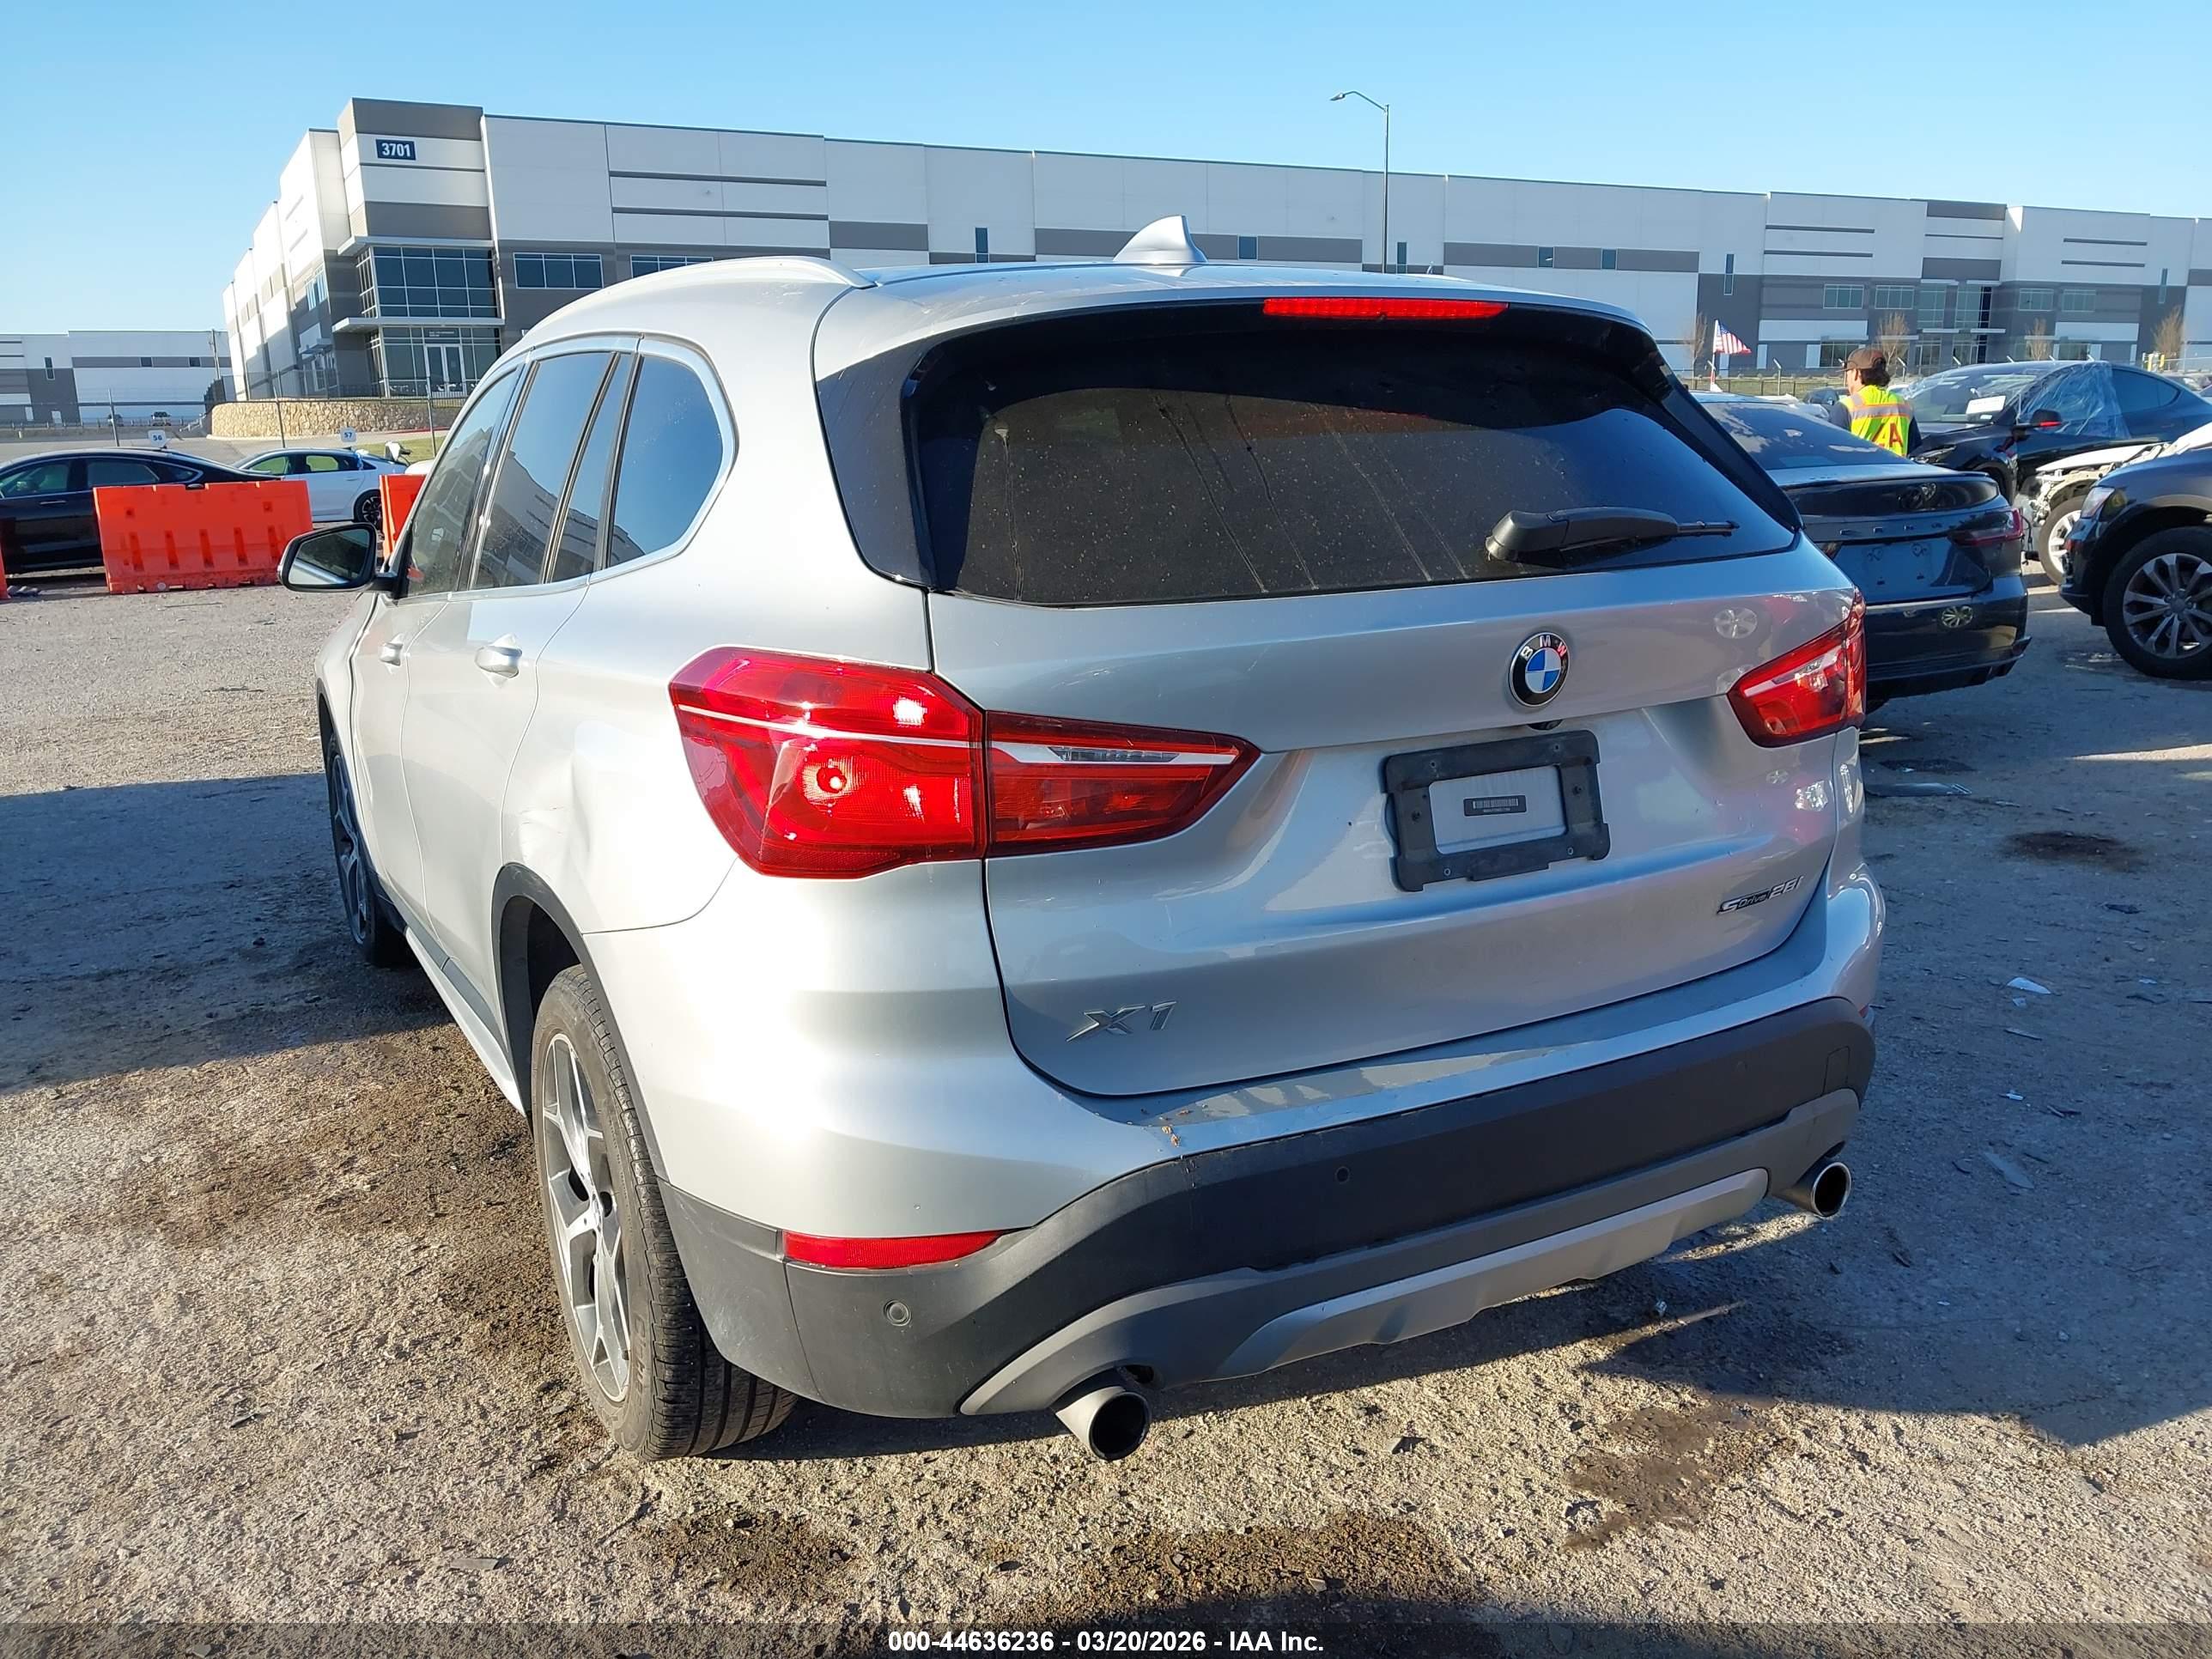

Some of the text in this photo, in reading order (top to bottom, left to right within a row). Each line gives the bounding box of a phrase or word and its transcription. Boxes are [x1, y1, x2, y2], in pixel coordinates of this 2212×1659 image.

[381, 143, 410, 156] 3701
[1520, 635, 1567, 661] BMW
[1066, 1000, 1176, 1042] X1
